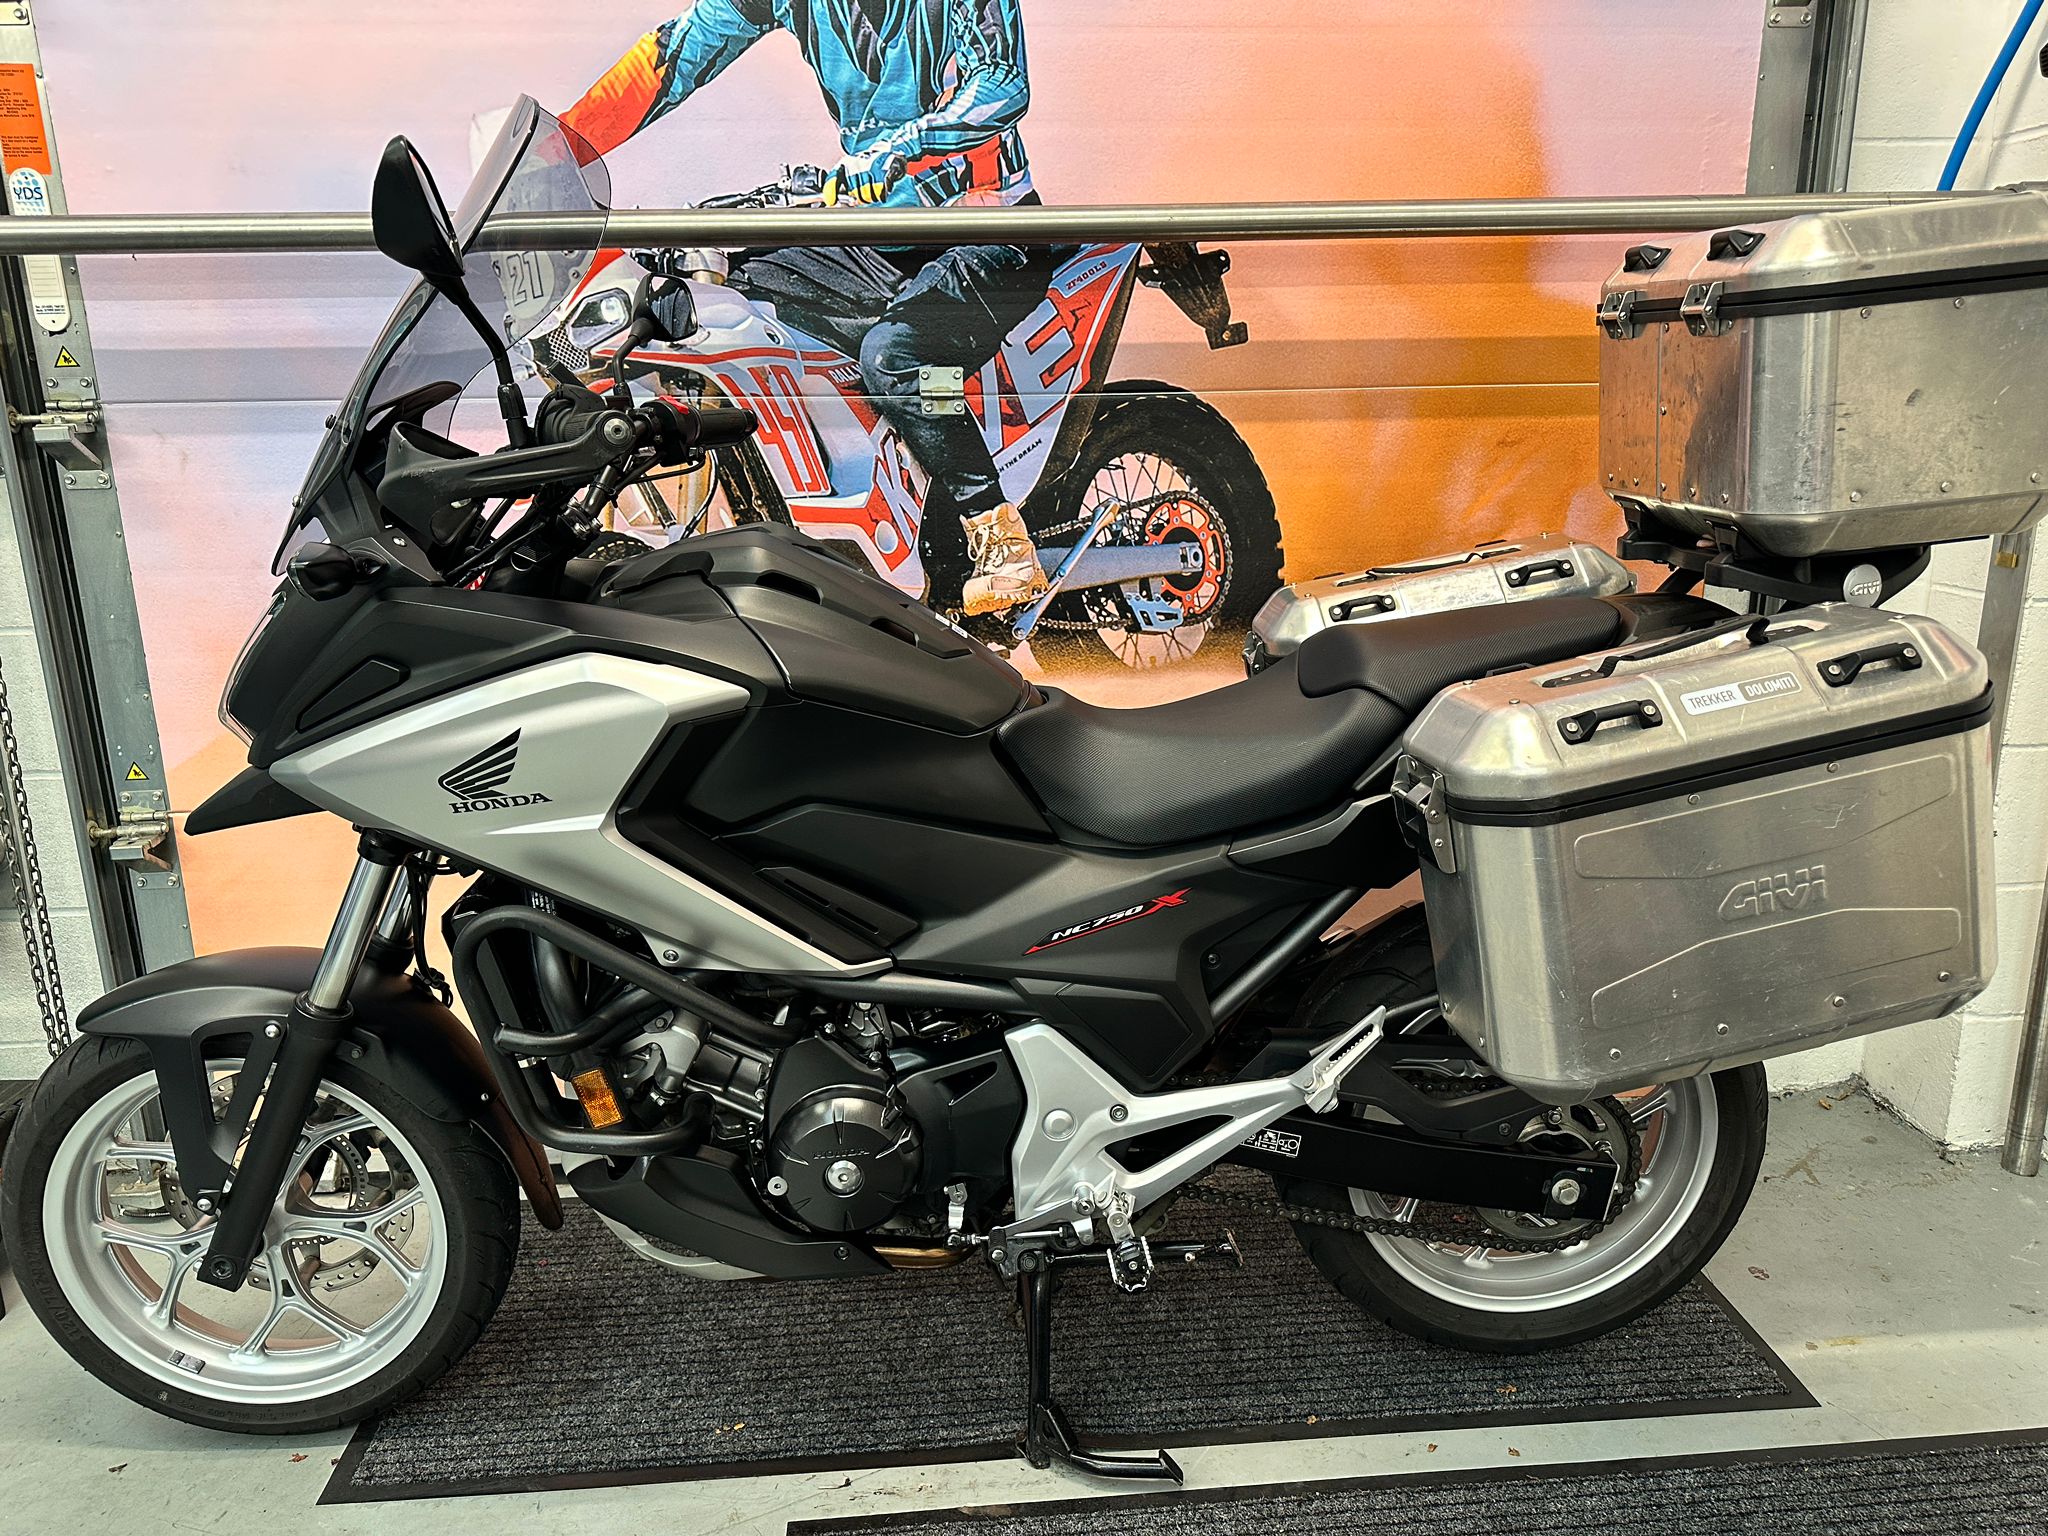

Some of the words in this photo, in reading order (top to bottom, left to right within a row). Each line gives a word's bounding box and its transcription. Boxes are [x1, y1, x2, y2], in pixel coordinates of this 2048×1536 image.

[13, 187, 43, 199] YDS
[506, 250, 544, 306] 21
[1004, 457, 1018, 469] THE
[1018, 438, 1043, 460] DREAM
[1850, 579, 1880, 596] GIVI
[1688, 689, 1736, 709] TREKKER
[1744, 676, 1796, 697] DOLOMITI
[448, 792, 553, 814] HONDA
[1718, 864, 1826, 922] GIVI
